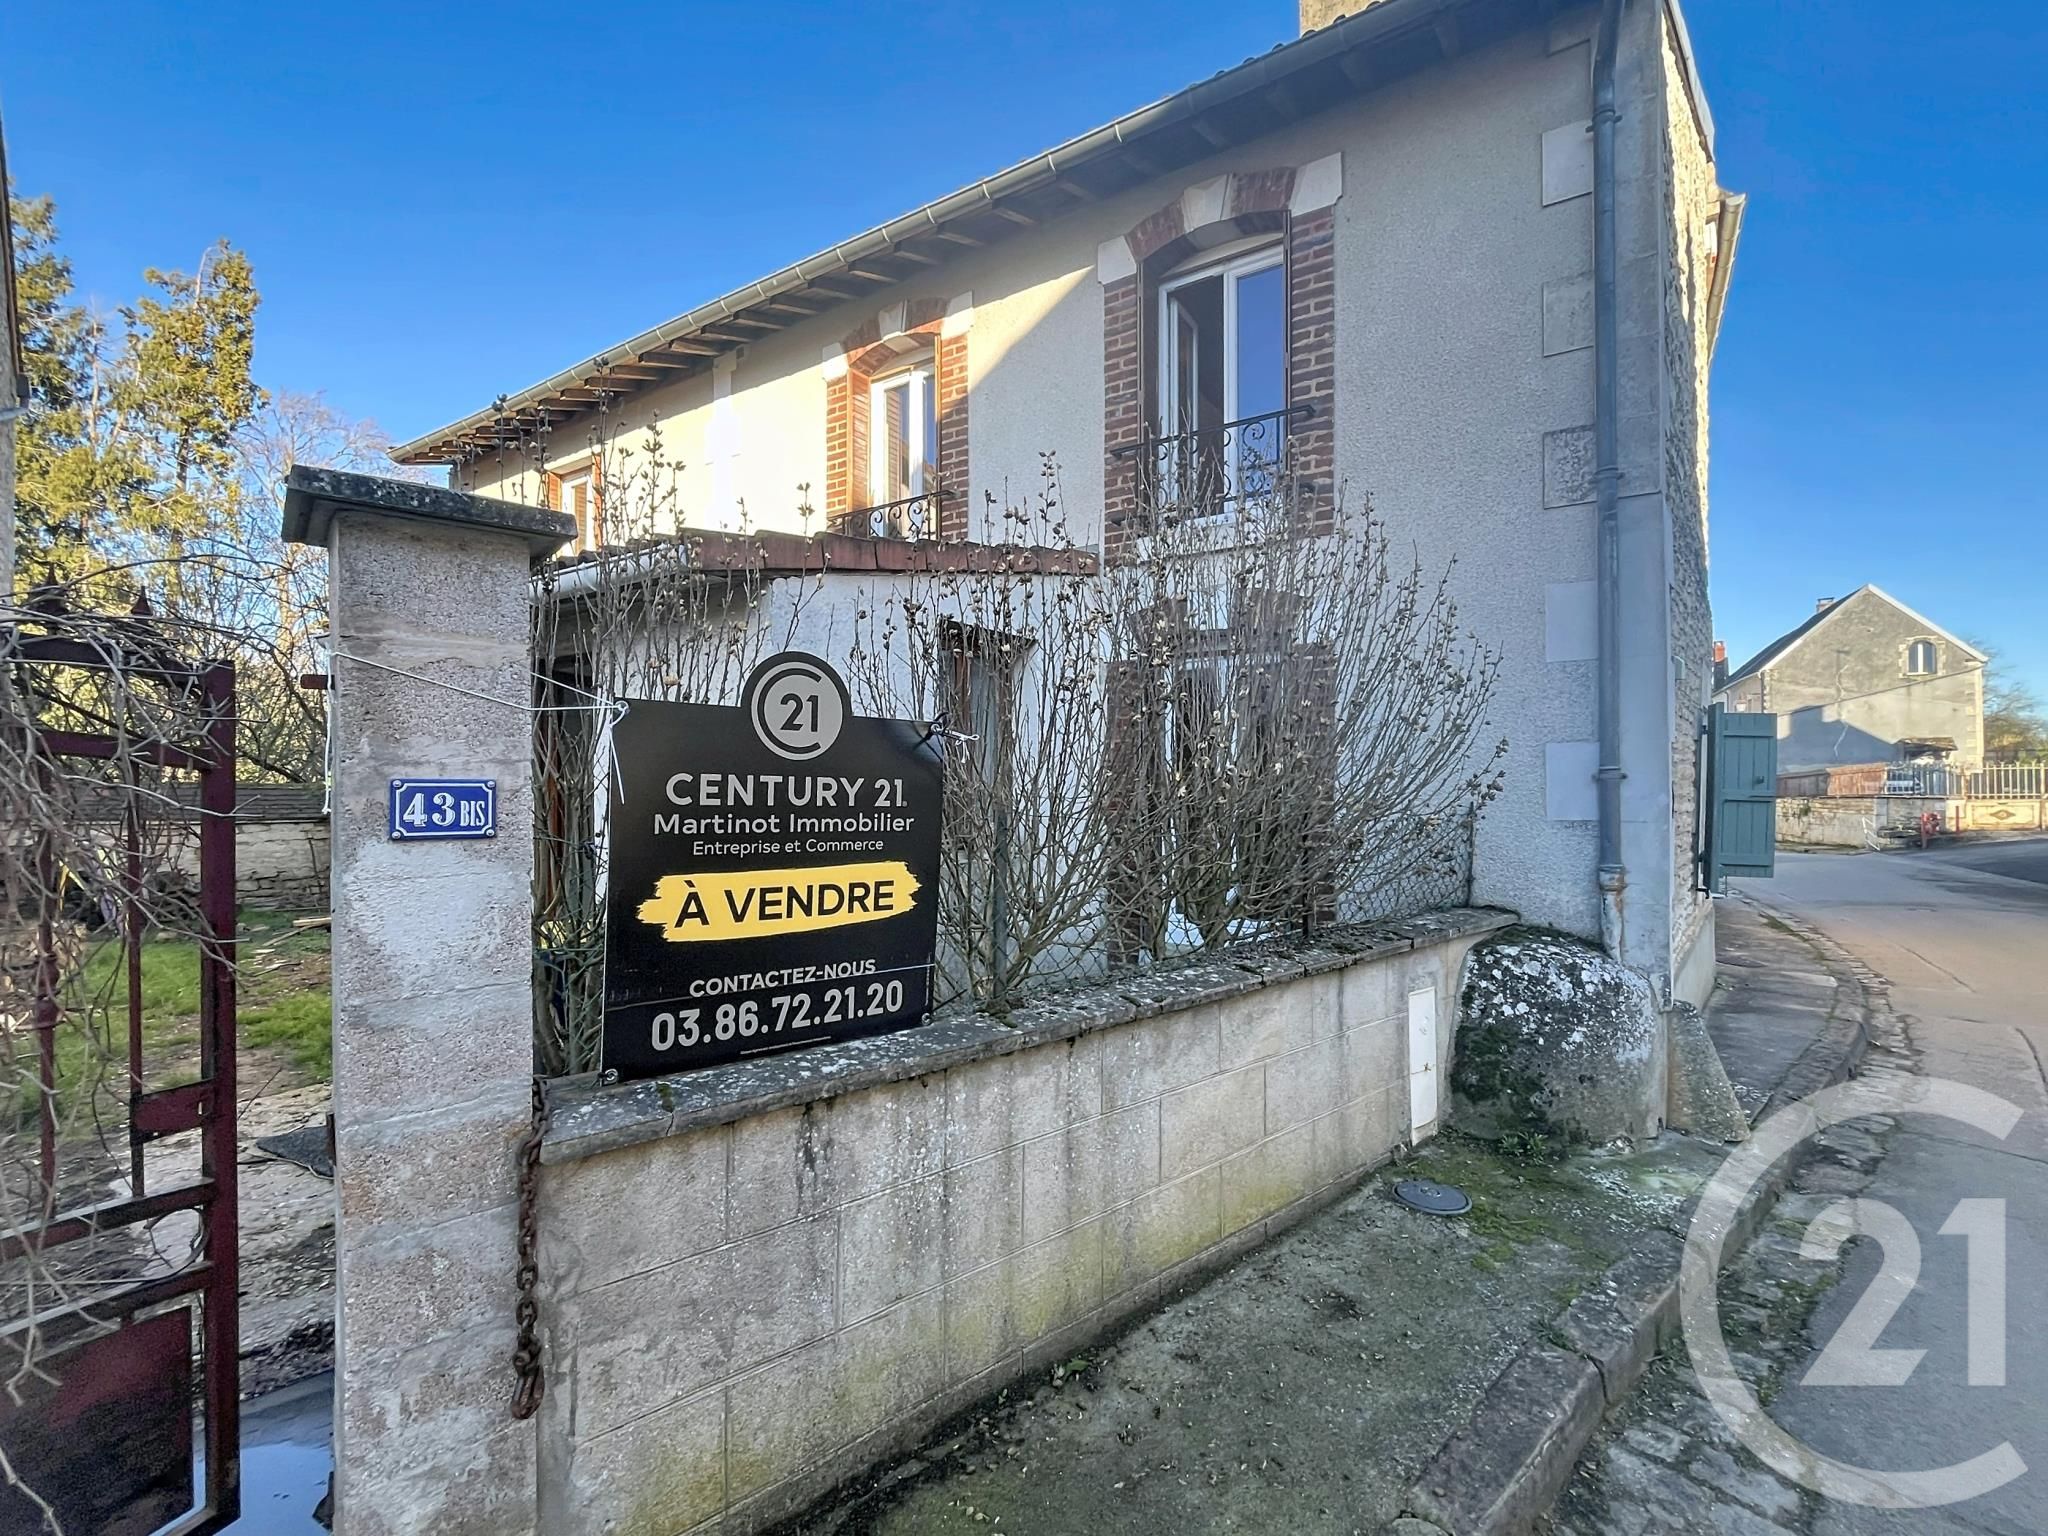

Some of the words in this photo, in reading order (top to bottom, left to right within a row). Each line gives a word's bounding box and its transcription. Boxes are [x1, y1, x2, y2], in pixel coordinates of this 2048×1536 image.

[665, 772, 864, 807] CENTURY
[402, 792, 456, 827] 43
[459, 800, 486, 827] BIS
[653, 813, 780, 835] Martinot
[789, 813, 915, 834] Immobilier
[692, 839, 781, 858] Entreprise
[784, 840, 801, 853] et
[805, 838, 884, 853] Commerce
[674, 879, 709, 928] À
[724, 880, 895, 923] VENDRE
[689, 958, 876, 998] CONTACTEZ-NOUS
[651, 980, 903, 1051] 03.86.72.21.20
